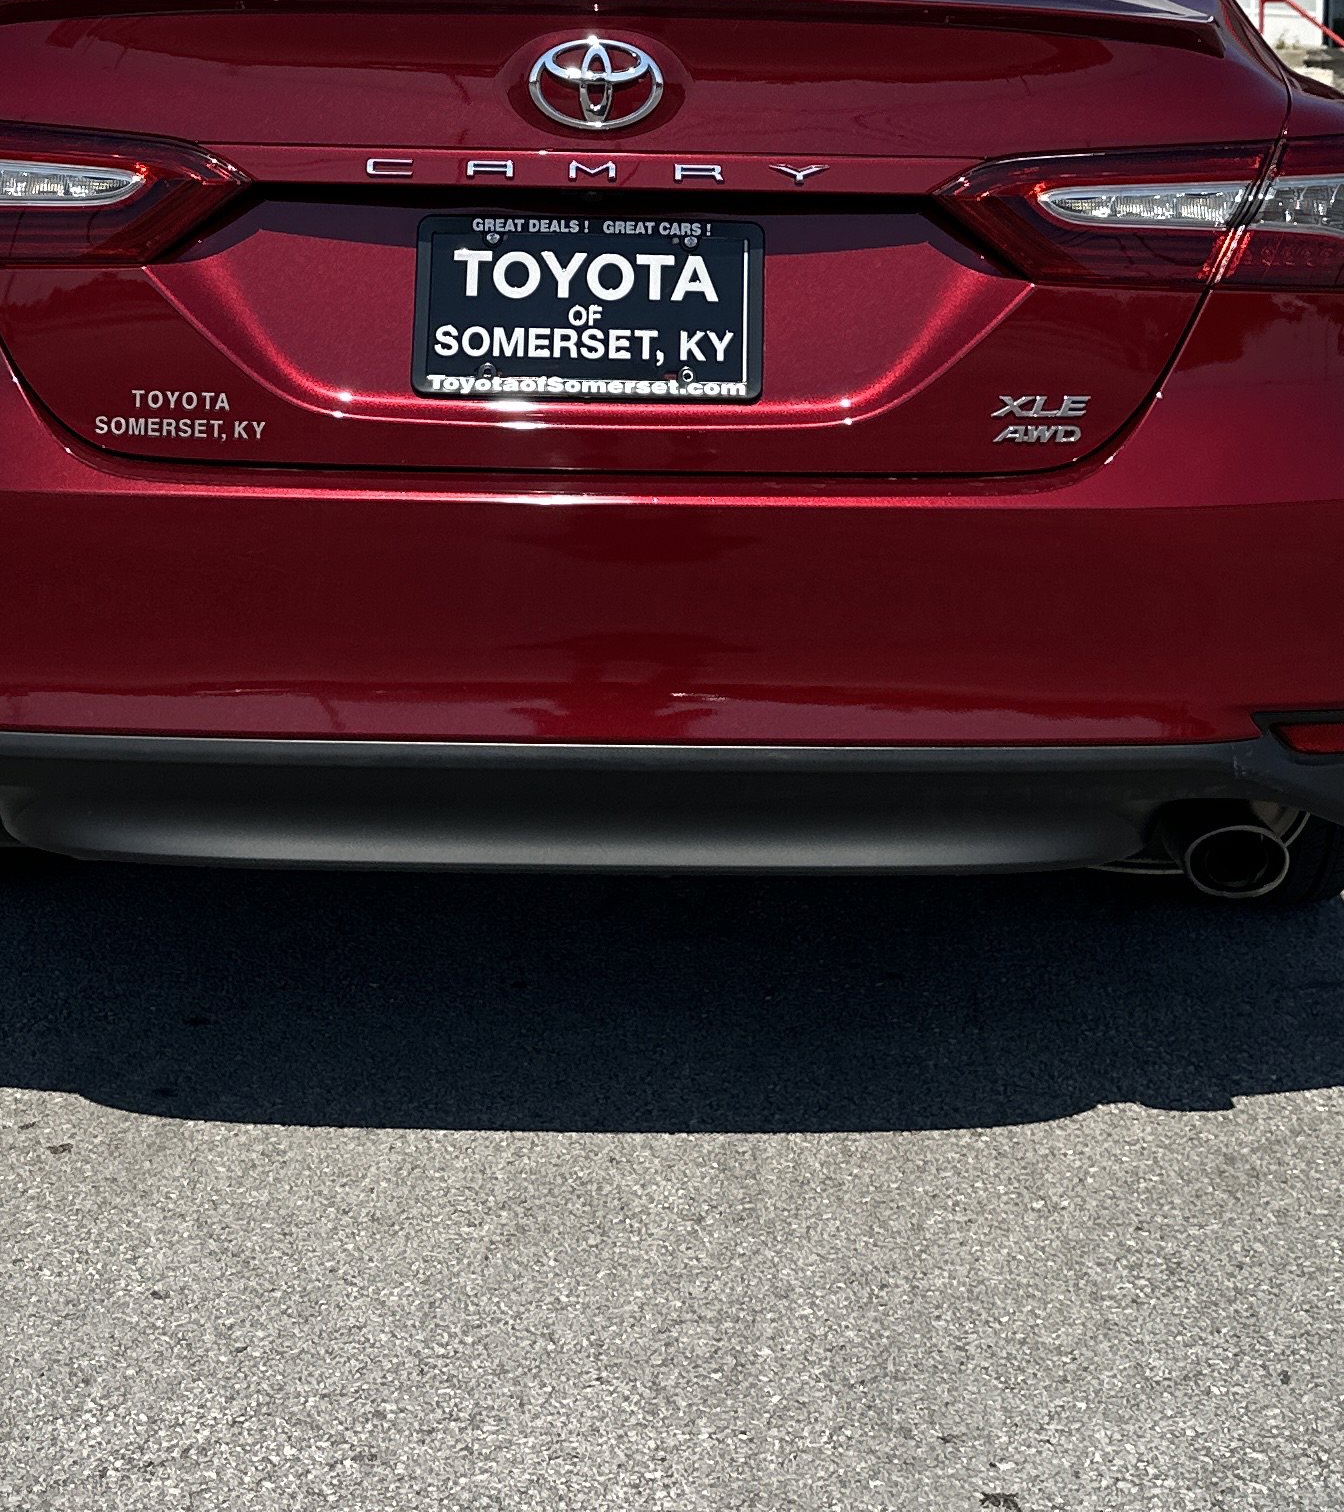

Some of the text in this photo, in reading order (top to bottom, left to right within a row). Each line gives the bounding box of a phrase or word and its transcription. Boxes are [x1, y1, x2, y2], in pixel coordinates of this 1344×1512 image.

[365, 157, 831, 185] CAMRY
[471, 217, 525, 232] GREAT
[602, 220, 656, 235] GREAT
[452, 248, 720, 303] TOYOTA
[567, 303, 604, 328] OF
[433, 324, 735, 368] SOMERSET, KY
[426, 374, 748, 397] ToyotaofSomerset.com
[131, 389, 231, 412] TOYOTA
[990, 395, 1092, 418] XLE
[94, 415, 267, 442] SOMERSET, KY
[991, 425, 1083, 443] AWD
